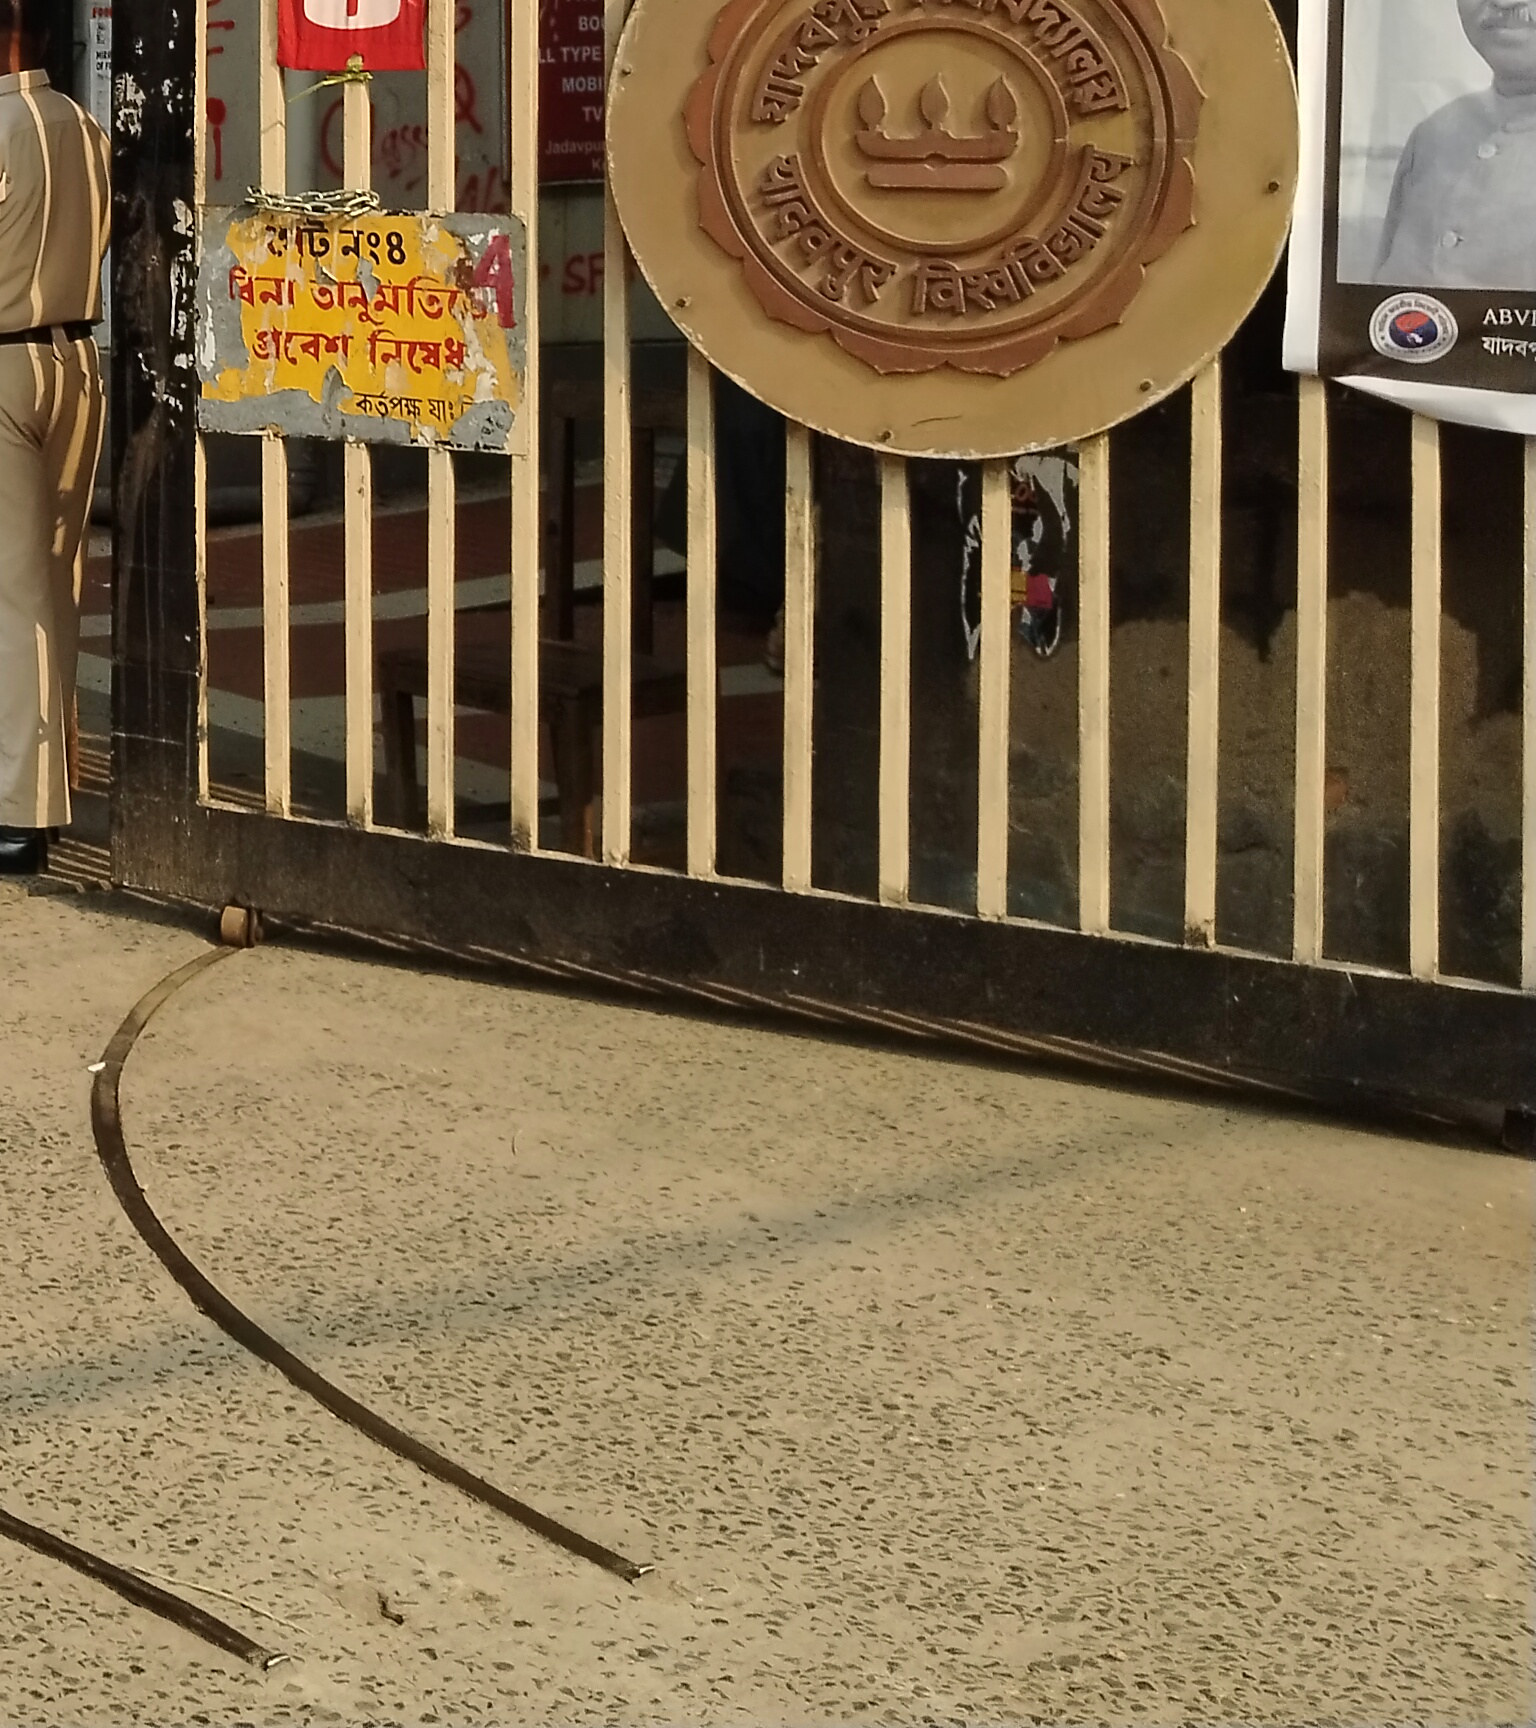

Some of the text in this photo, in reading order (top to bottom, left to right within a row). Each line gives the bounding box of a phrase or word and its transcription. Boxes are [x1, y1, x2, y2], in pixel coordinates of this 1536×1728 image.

[562, 77, 604, 93] MOBI
[545, 139, 605, 156] Jadavpu
[228, 264, 296, 308] বিনা
[367, 328, 467, 374] নিষেধ
